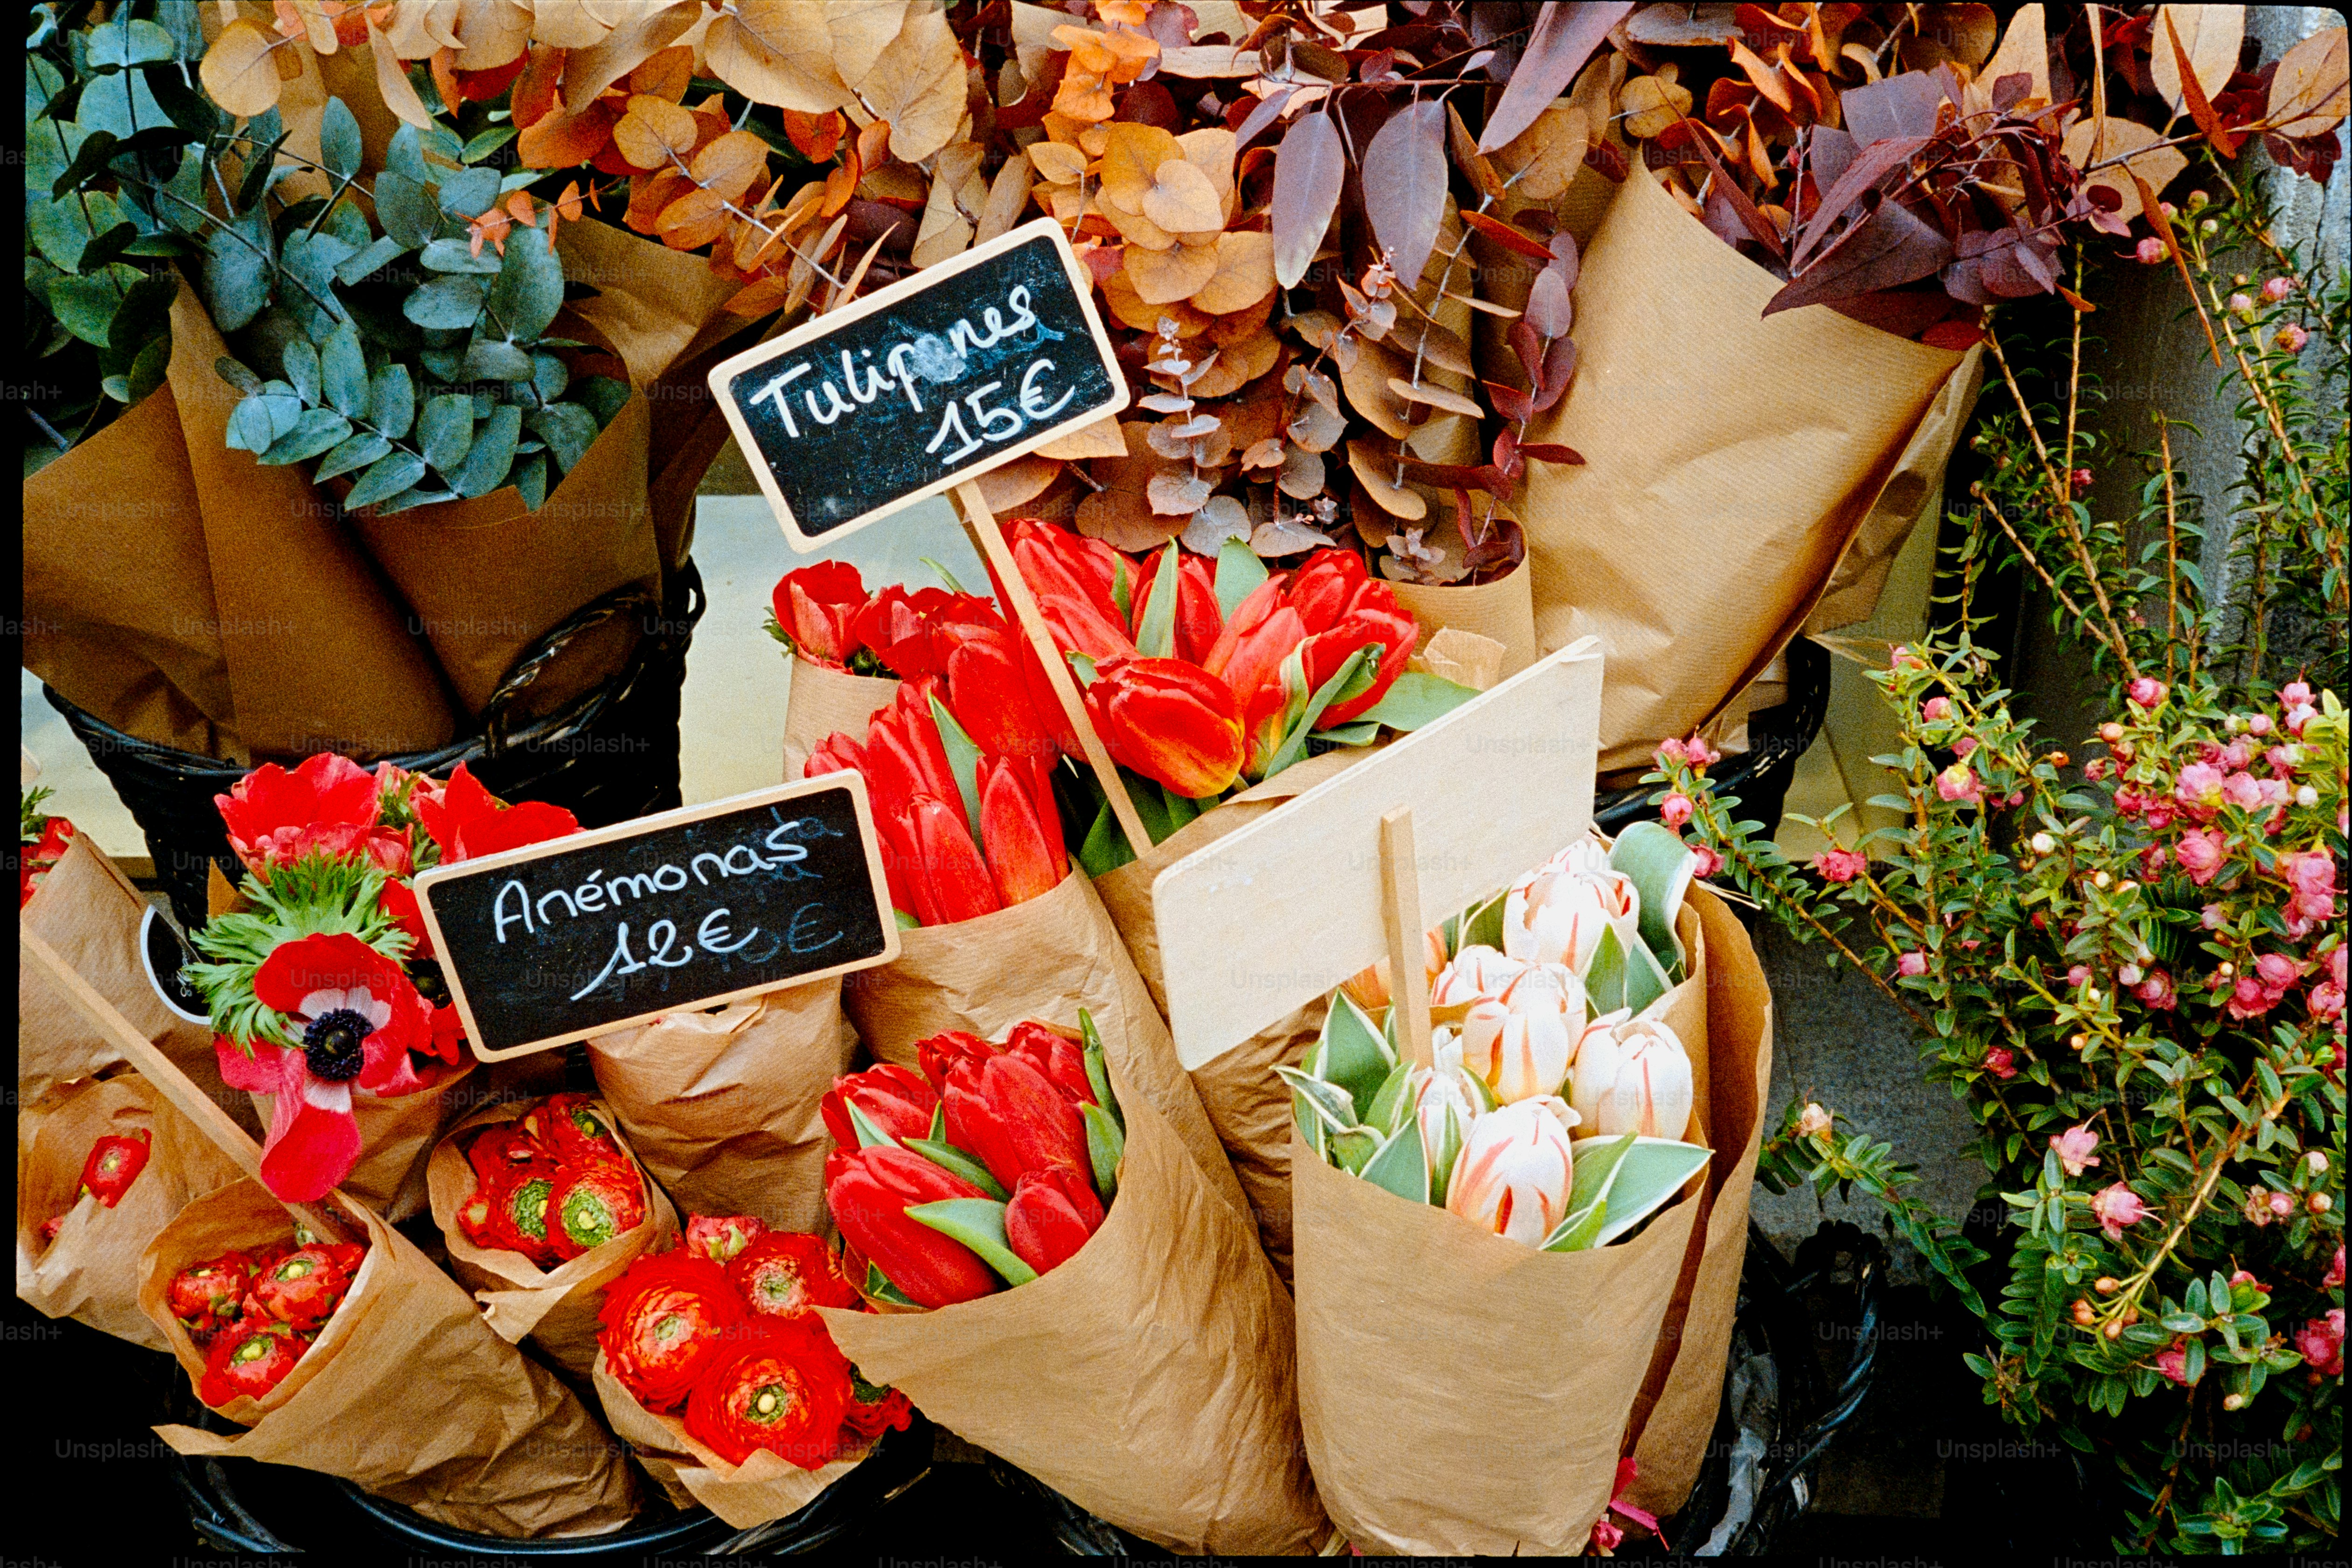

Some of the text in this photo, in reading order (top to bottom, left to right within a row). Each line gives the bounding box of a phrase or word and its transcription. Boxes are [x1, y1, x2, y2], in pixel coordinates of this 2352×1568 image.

[749, 285, 1037, 438] Tulipnes
[925, 359, 1075, 465] 15€
[570, 908, 759, 1001] 12€
